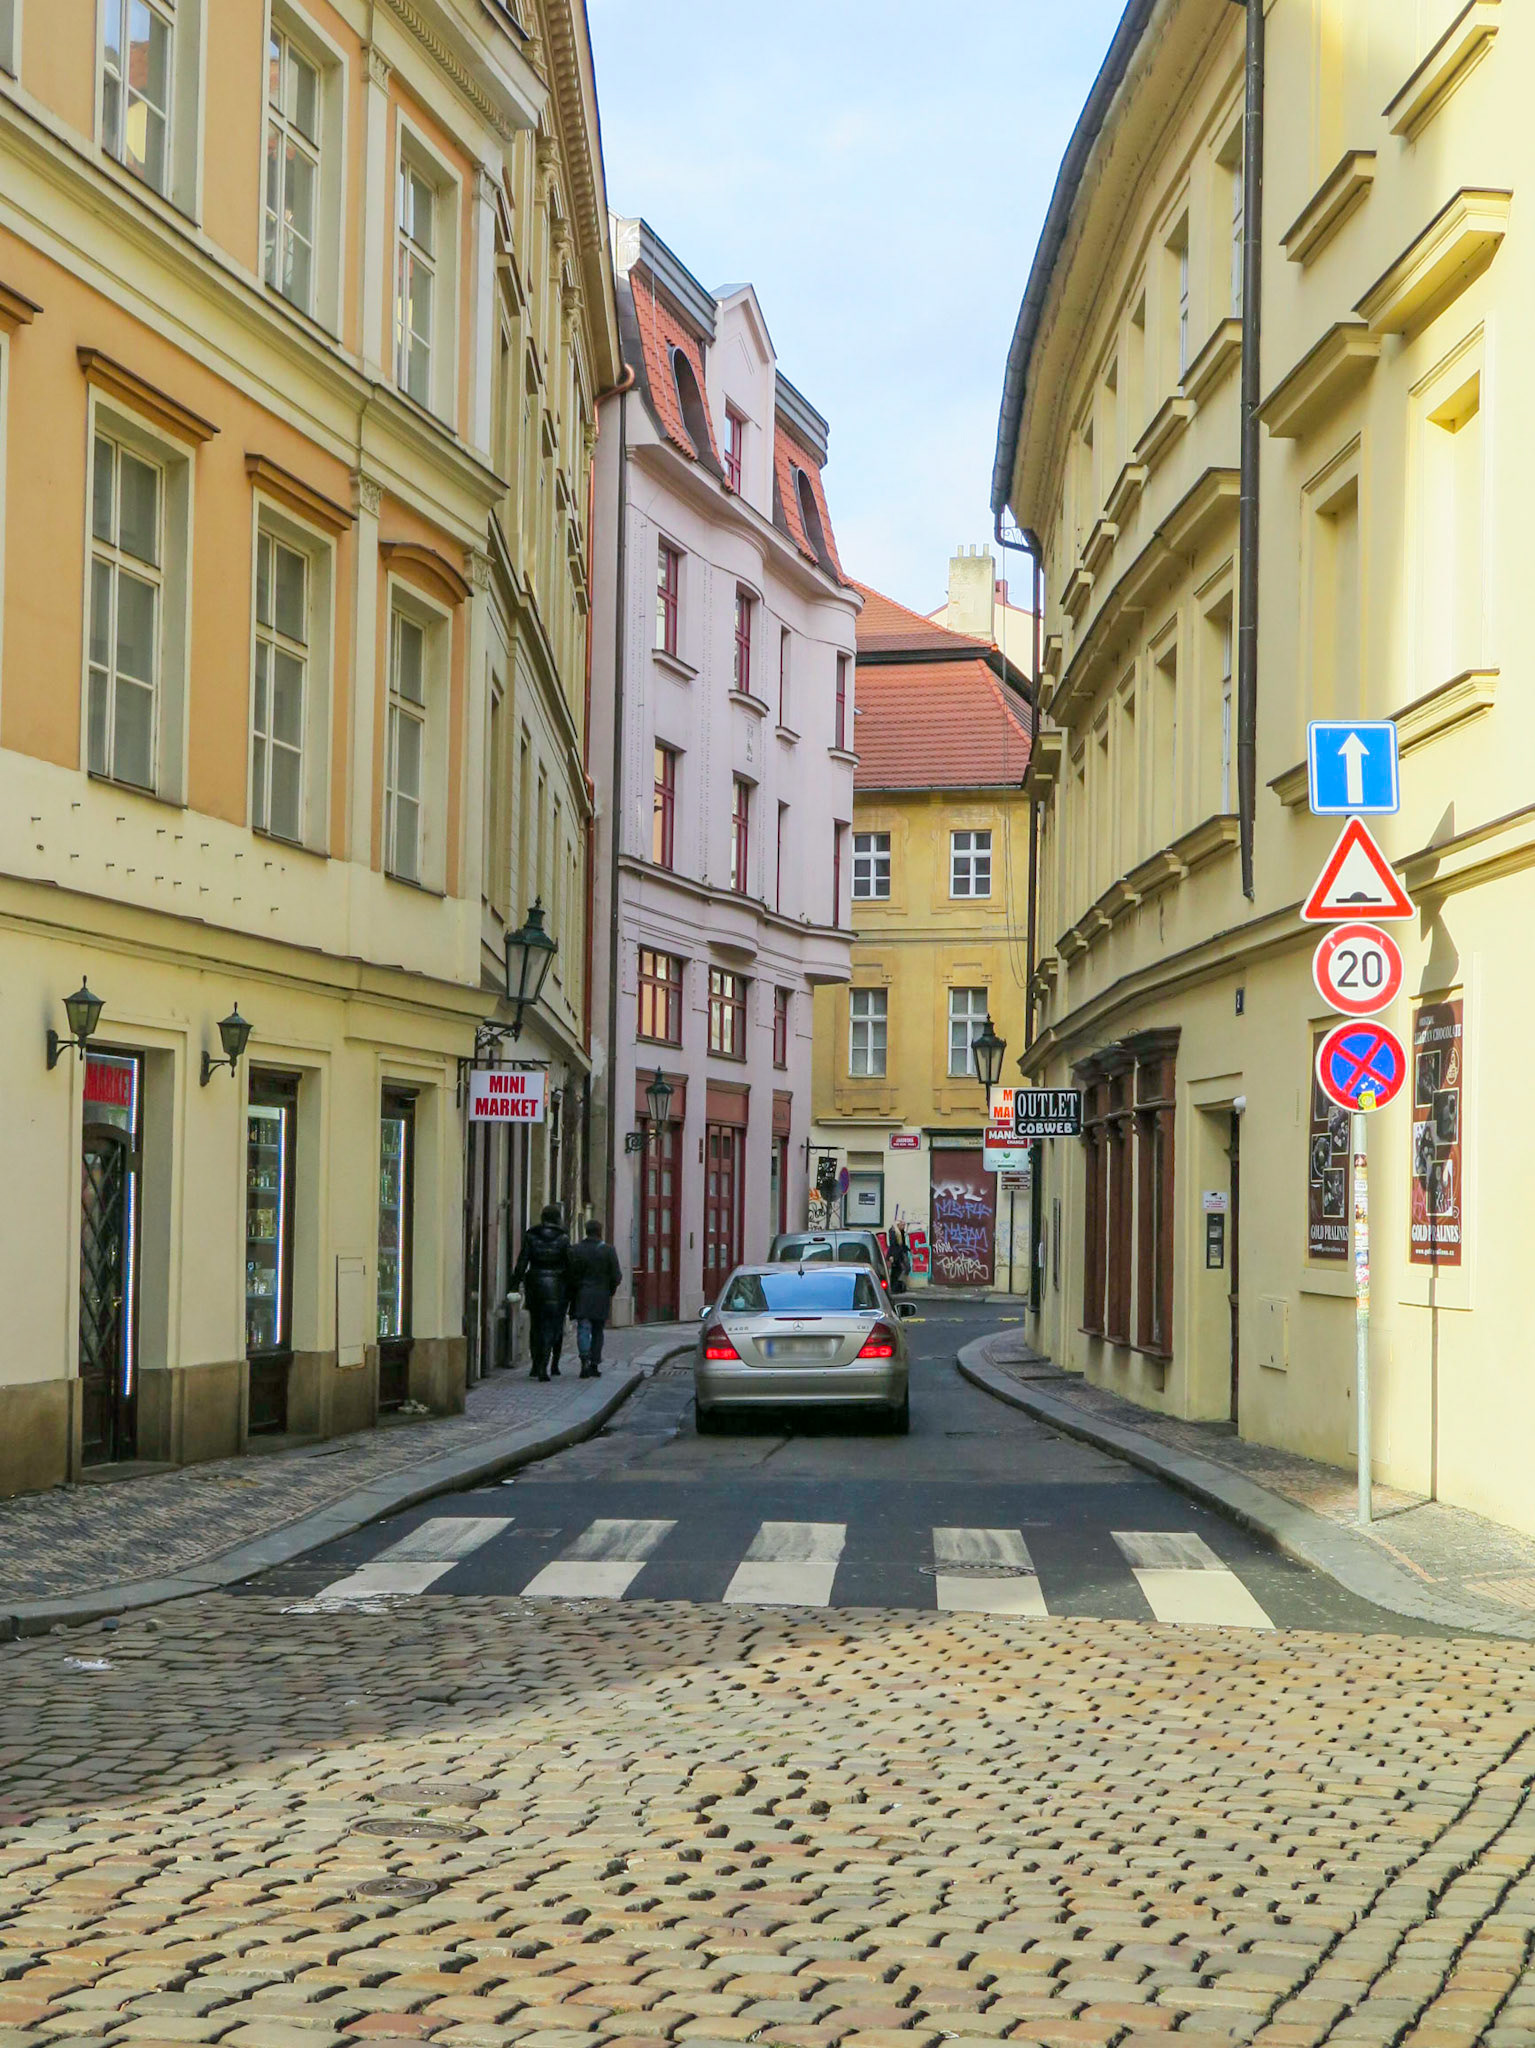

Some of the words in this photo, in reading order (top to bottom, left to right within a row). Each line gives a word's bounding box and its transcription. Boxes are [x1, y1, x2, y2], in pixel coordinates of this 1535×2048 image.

[1337, 950, 1383, 988] 20
[489, 1075, 526, 1094] MINI
[475, 1098, 538, 1117] MARKET
[1016, 1092, 1078, 1118] OUTLET
[1018, 1122, 1073, 1134] COBWEB
[1311, 1224, 1325, 1240] GOLD
[1411, 1223, 1428, 1241] GOLD
[1427, 1224, 1459, 1243] PRALINES
